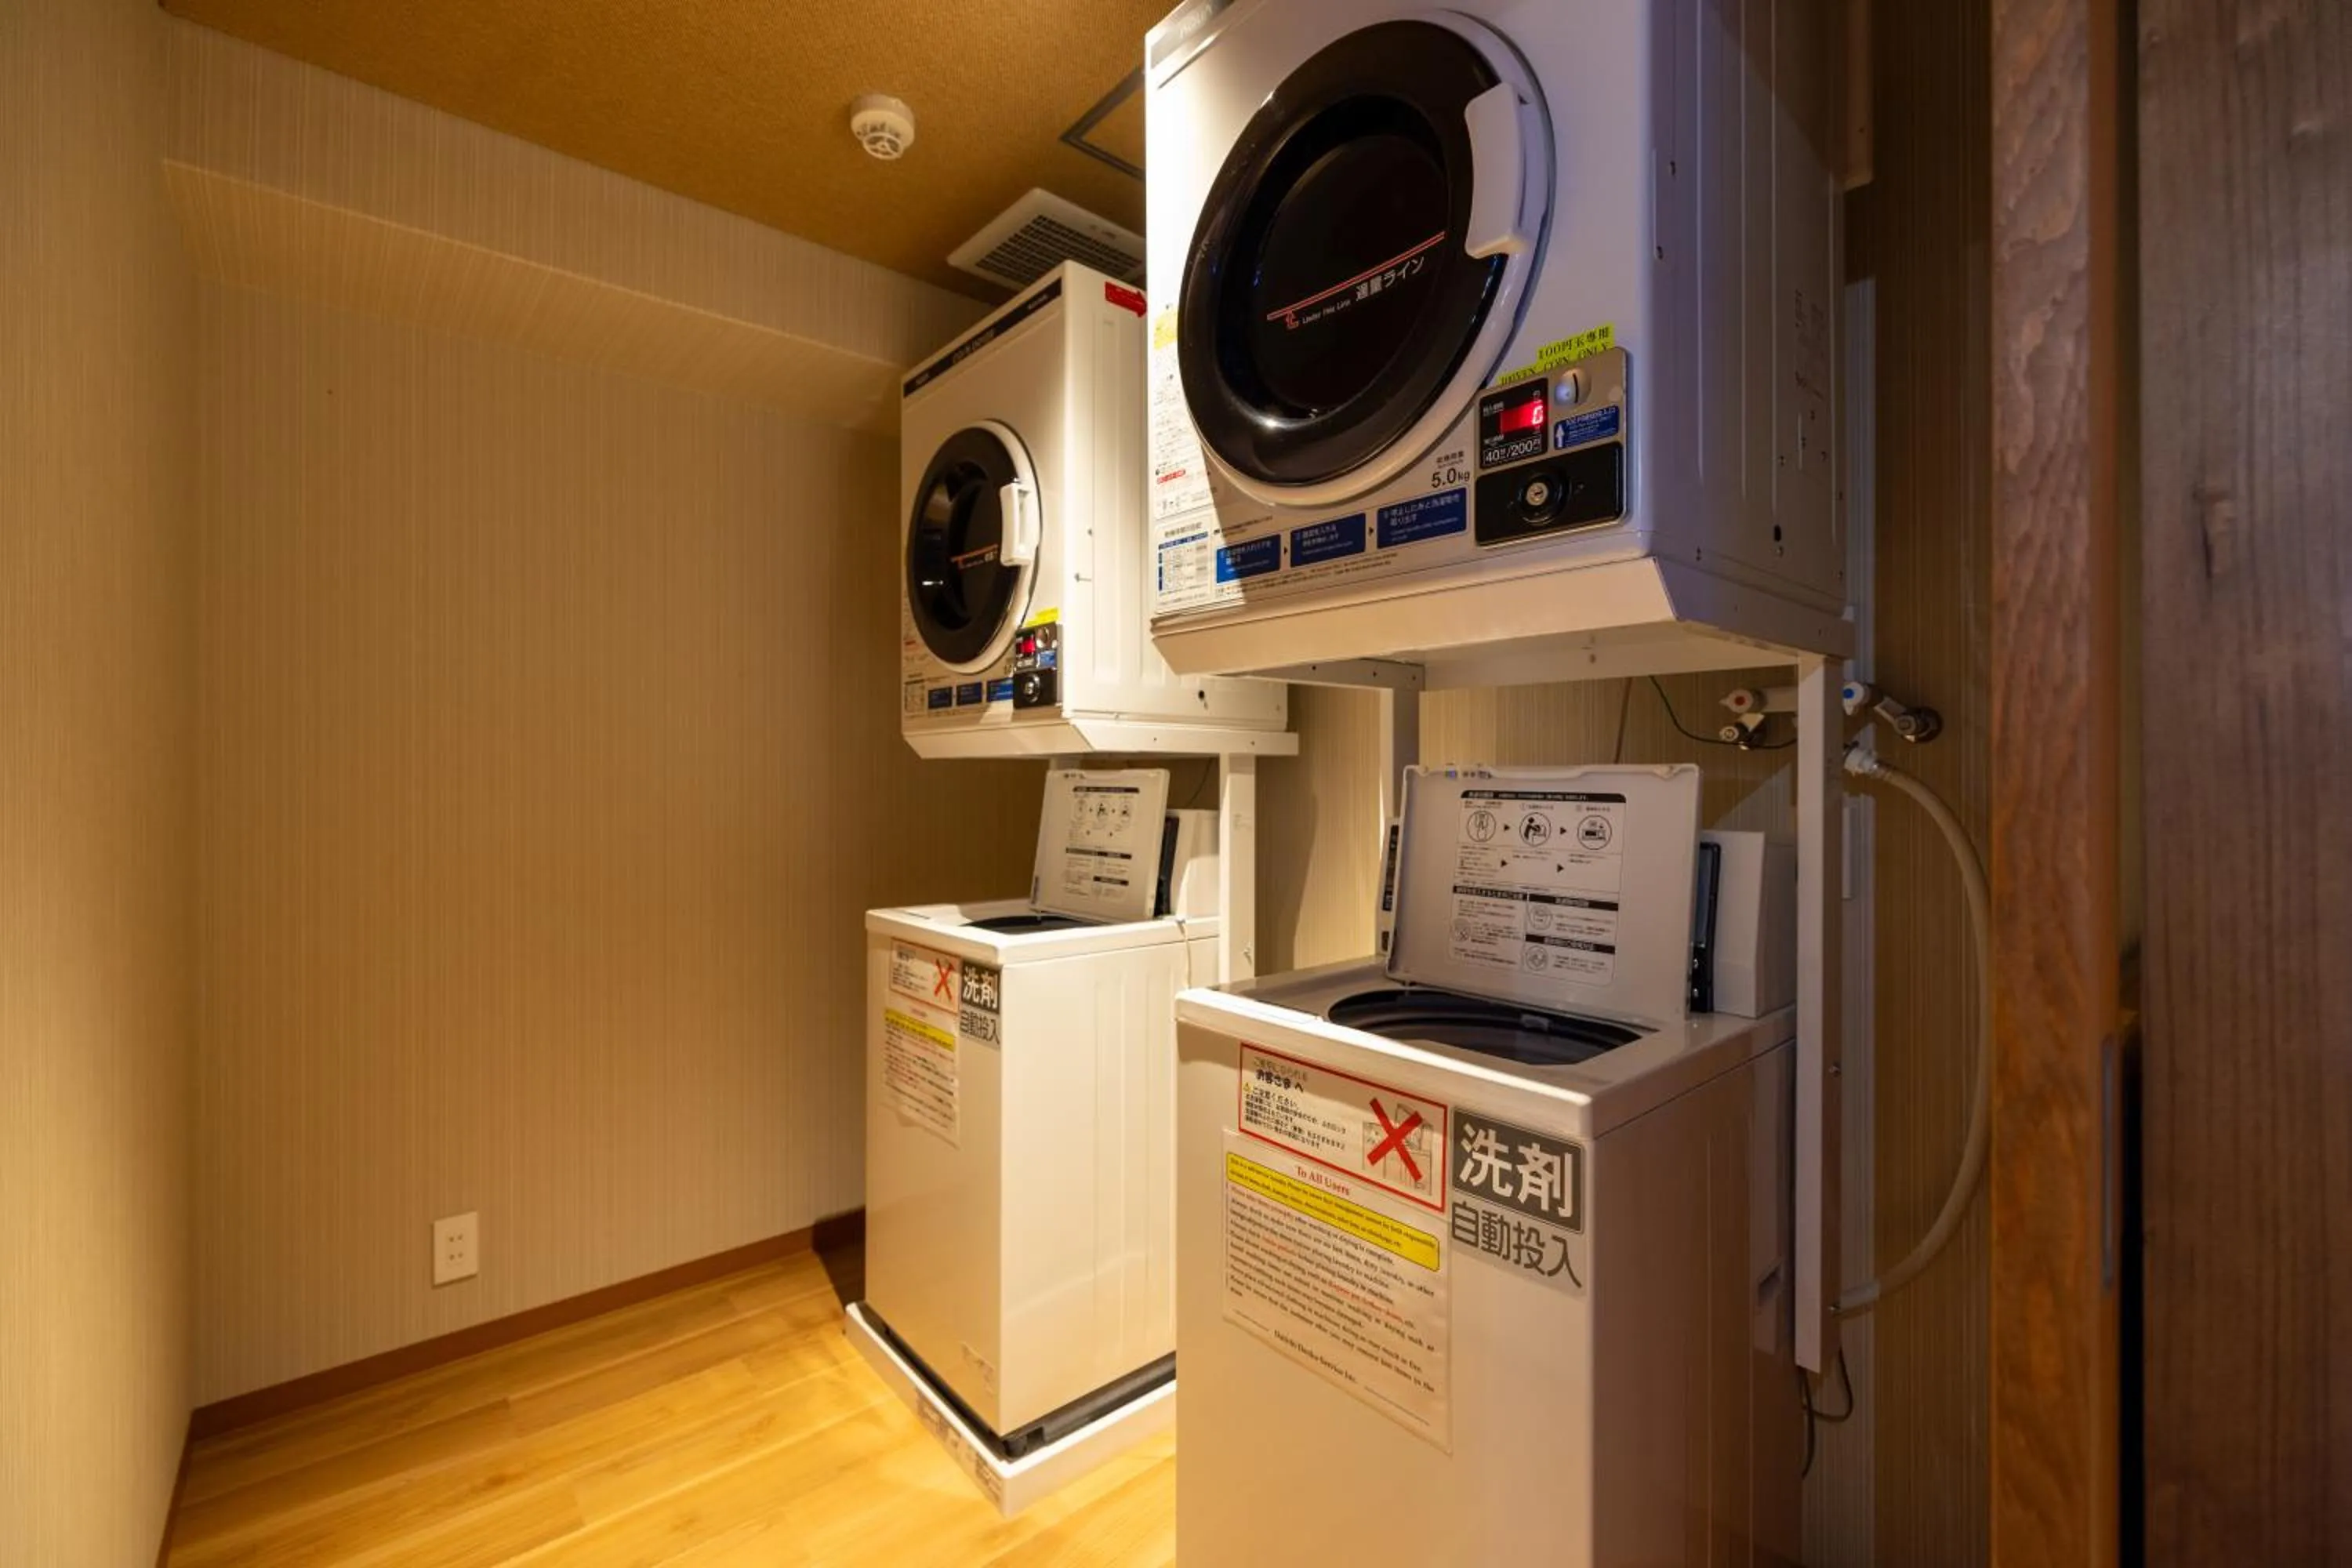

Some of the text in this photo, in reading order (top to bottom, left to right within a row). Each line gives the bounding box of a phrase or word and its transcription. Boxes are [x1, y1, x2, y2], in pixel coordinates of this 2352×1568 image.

[964, 965, 998, 1009] 洗剤
[1308, 1170, 1322, 1185] All
[1324, 1176, 1349, 1196] Users
[1458, 1123, 1573, 1217] 洗剤
[1452, 1200, 1582, 1289] 自動投入
